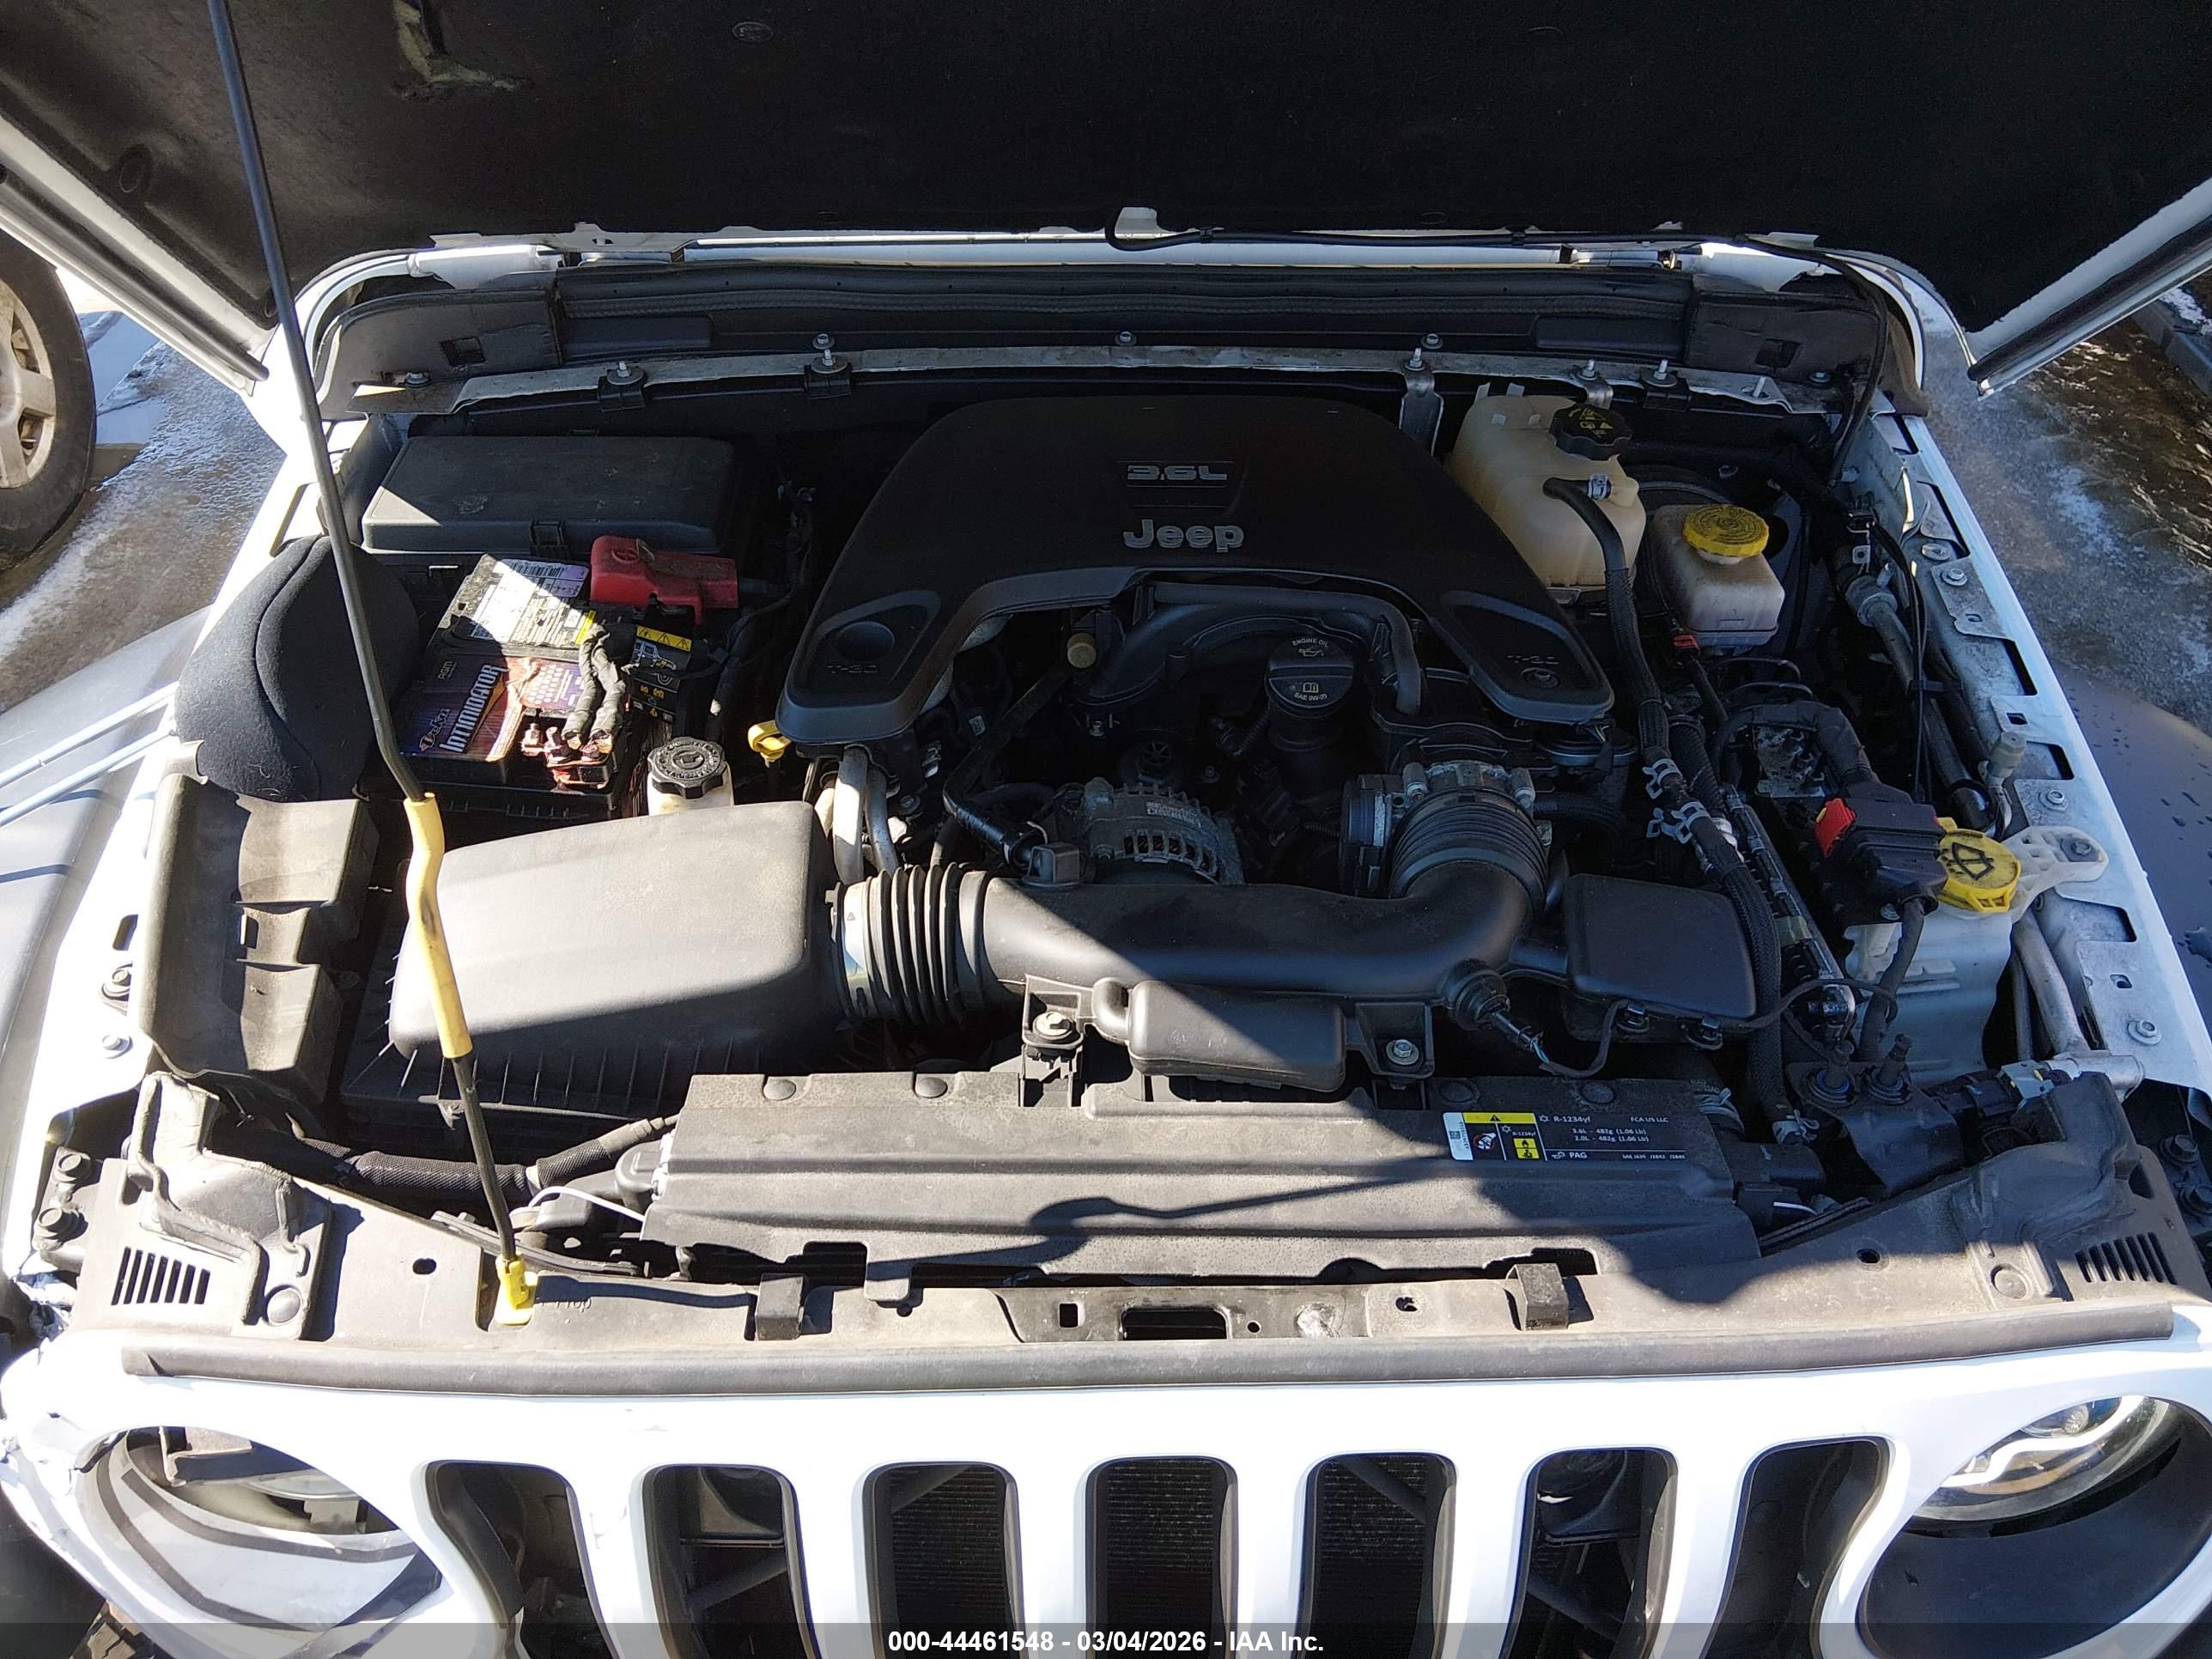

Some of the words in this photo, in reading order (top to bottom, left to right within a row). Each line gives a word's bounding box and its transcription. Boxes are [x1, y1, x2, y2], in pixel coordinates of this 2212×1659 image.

[1127, 465, 1228, 482] 3.6L
[1123, 519, 1244, 553] Jeep
[1291, 638, 1318, 647] ENGINE
[1319, 639, 1328, 648] OIL
[1294, 692, 1308, 701] SAE
[419, 707, 451, 752] Deka
[1553, 1115, 1590, 1124] R-1234yf
